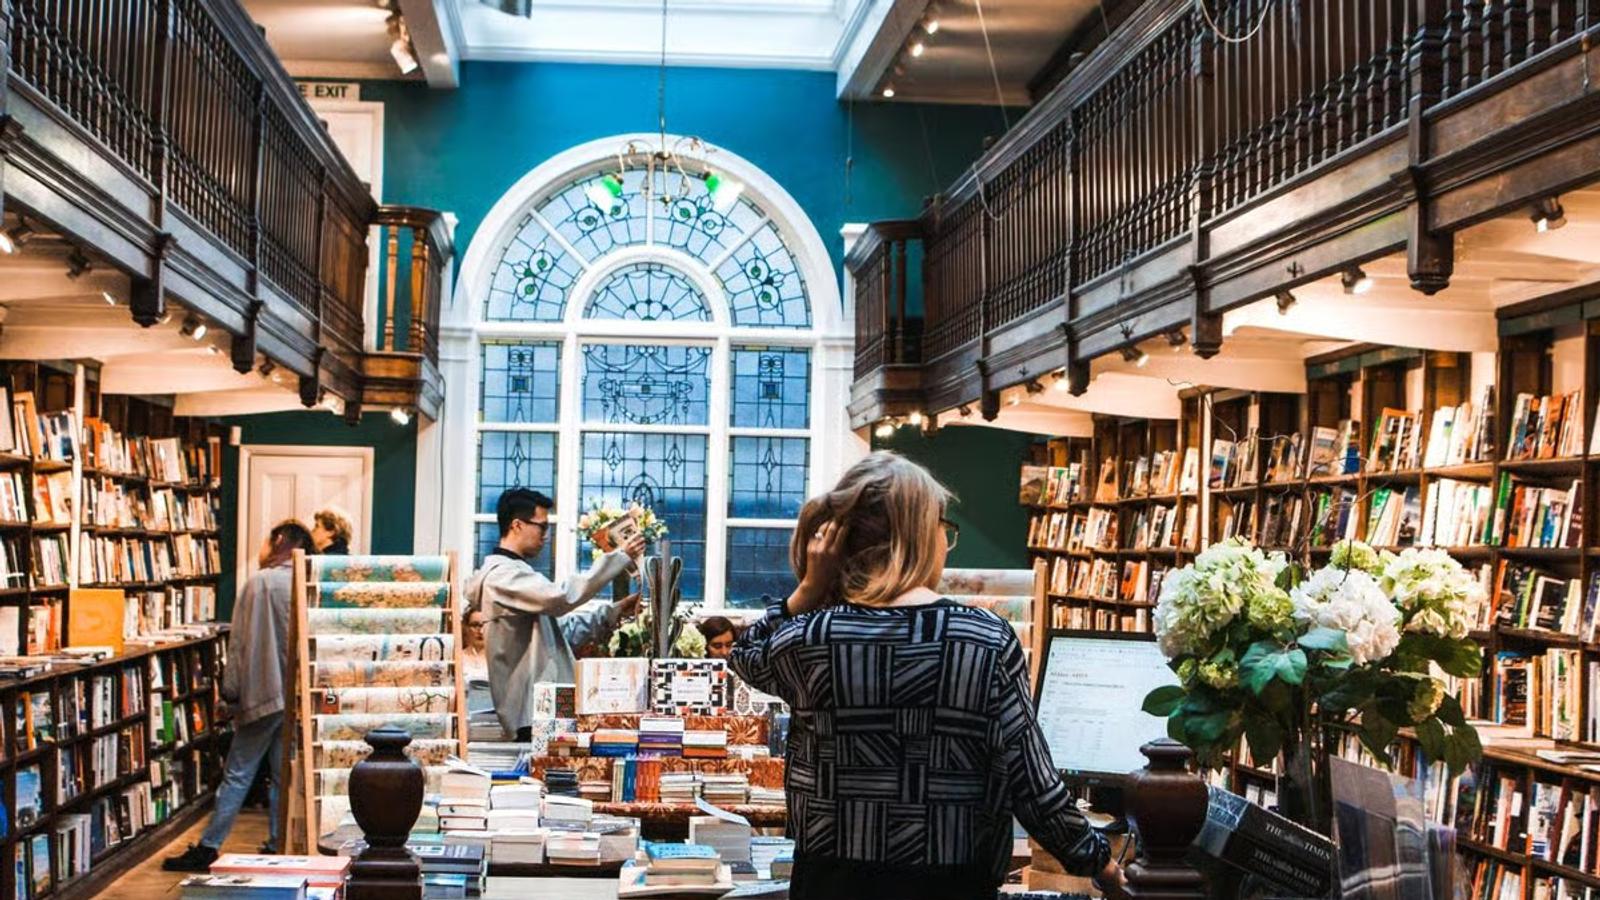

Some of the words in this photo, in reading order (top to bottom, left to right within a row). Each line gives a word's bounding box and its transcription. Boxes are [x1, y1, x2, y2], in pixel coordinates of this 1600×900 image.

[315, 84, 348, 98] EXIT
[1265, 823, 1282, 837] THE
[1304, 842, 1331, 860] TIMES
[1294, 868, 1320, 887] TIMES
